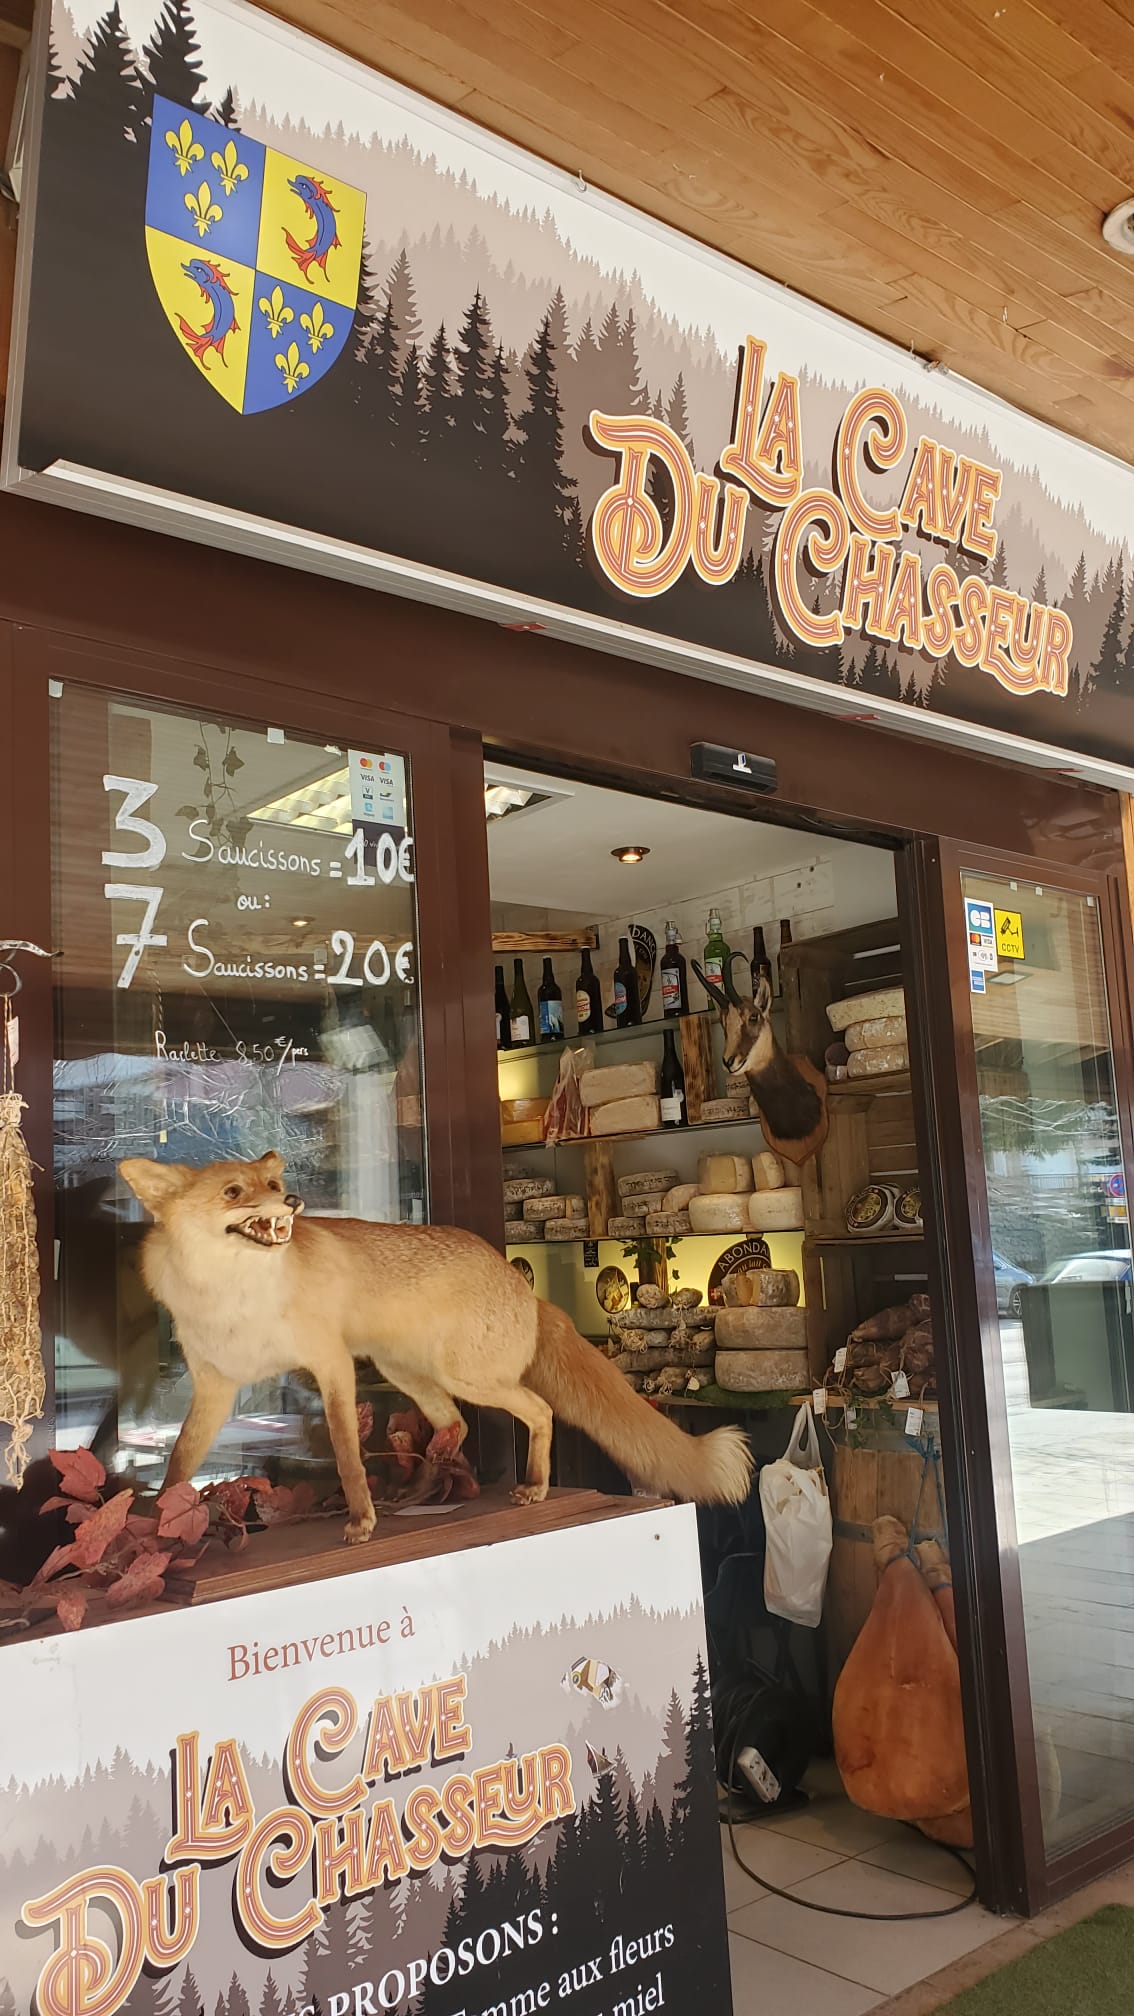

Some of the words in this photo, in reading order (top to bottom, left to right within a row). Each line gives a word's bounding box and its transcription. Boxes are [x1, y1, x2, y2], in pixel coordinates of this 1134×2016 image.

[720, 335, 803, 507] LA
[837, 386, 1003, 560] CAVE
[589, 410, 748, 597] DU
[774, 487, 1072, 697] CHASSEUR
[360, 773, 375, 782] VISA
[379, 777, 394, 786] VISA
[102, 775, 167, 871] 3
[181, 819, 321, 876] Saucissons
[104, 883, 168, 989] 7
[183, 918, 309, 980] Saucissons
[1001, 943, 1020, 953] CCTV
[155, 1030, 221, 1062] Raclette
[718, 1242, 769, 1272] ABONDA
[226, 1619, 391, 1682] Bienvenue
[399, 1605, 416, 1639] à
[165, 1730, 255, 1862] LA
[287, 1673, 472, 1819] CAVE
[21, 1863, 201, 2016] DU
[236, 1743, 576, 1949] CHASSEUR
[558, 1956, 603, 1998] aux
[609, 1923, 675, 1974] fleurs
